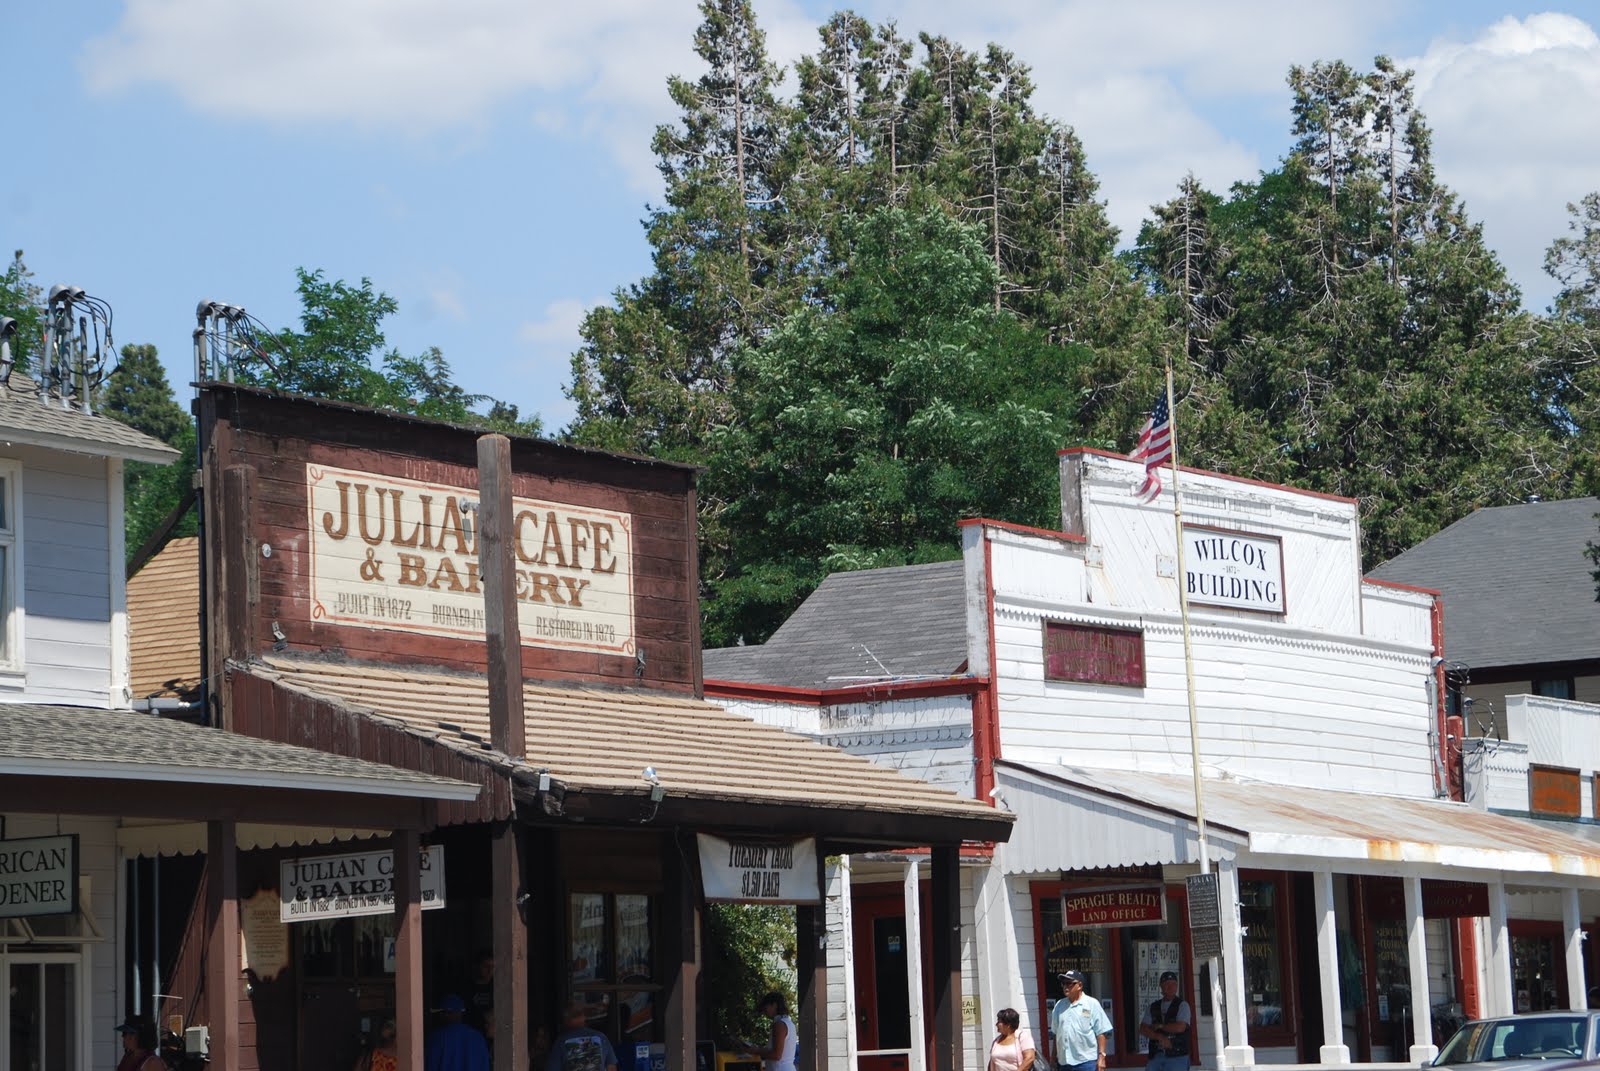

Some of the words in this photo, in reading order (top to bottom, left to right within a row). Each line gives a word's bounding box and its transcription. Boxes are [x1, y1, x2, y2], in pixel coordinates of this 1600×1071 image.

[514, 509, 617, 575] CAFE
[1194, 537, 1267, 572] WILCOX
[359, 547, 385, 582] &
[1186, 571, 1277, 604] BUILDING
[338, 592, 370, 614] BUILT
[373, 597, 385, 617] IN
[387, 599, 412, 620] 1872
[432, 603, 470, 627] BURNED
[536, 616, 582, 640] RESTORED
[290, 858, 366, 887] JULIAN
[761, 871, 780, 898] EACH
[295, 885, 308, 902] &
[311, 878, 395, 899] BAKE
[1066, 893, 1115, 913] SPRAGUE
[1118, 891, 1160, 907] REALTY
[290, 901, 308, 915] BUILT
[1082, 912, 1107, 923] LAND
[1111, 908, 1147, 920] OFFICE
